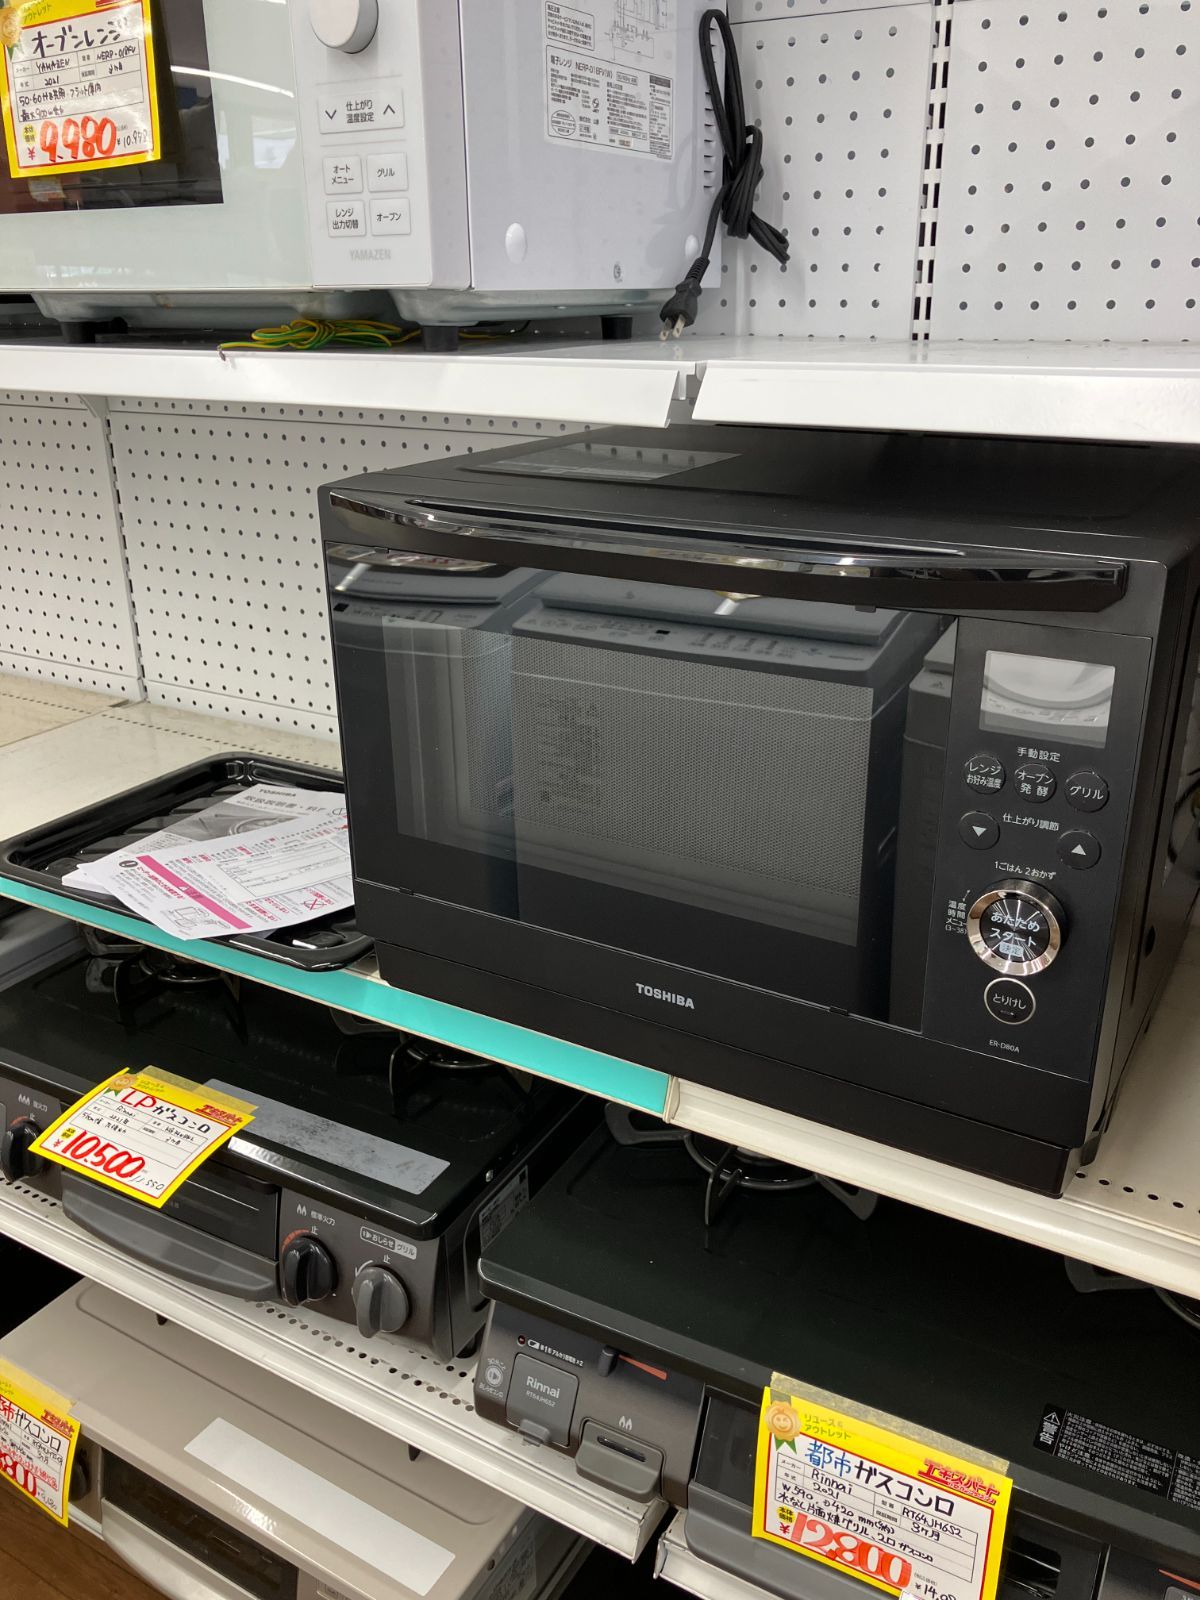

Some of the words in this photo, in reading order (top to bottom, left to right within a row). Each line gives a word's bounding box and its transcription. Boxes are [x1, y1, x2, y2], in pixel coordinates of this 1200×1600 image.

[346, 99, 372, 111] 仕上がり
[347, 112, 374, 123] 温度設定
[333, 164, 351, 174] オート
[377, 168, 395, 178] グリル
[331, 176, 354, 185] メニュー
[335, 208, 354, 218] レンジ
[333, 220, 358, 230] 出力切替
[350, 249, 391, 261] YAMAZEN
[1017, 746, 1061, 763] 手動設定
[969, 762, 1001, 776] レンジ
[966, 774, 1002, 789] お好み温度
[1069, 785, 1104, 800] グリル
[1002, 812, 1060, 831] 仕上がり調節
[994, 861, 1023, 874] 1ごはん
[1024, 867, 1057, 880] 2おかず
[948, 900, 967, 911] 温度
[947, 908, 966, 920] 時間
[991, 912, 1040, 932] あたため
[990, 927, 1036, 947] スタート
[635, 982, 695, 1010] TOSHIBA
[992, 993, 1027, 1010] とりけし
[989, 1039, 1020, 1053] ER-D80A
[311, 1226, 318, 1235] 止
[372, 1233, 394, 1248] おしらせ
[396, 1243, 415, 1256] グリル
[383, 1254, 391, 1264] 止
[526, 1376, 561, 1398] Rinnai
[804, 1424, 852, 1440] アウトレット
[804, 1440, 955, 1516] 都市ガスコンロ
[811, 1468, 853, 1495] Rinnai
[918, 1458, 1000, 1497] エキスパート
[813, 1483, 839, 1500] 2021
[780, 1506, 794, 1516] 本体
[901, 1506, 963, 1538] RT64JH6S2
